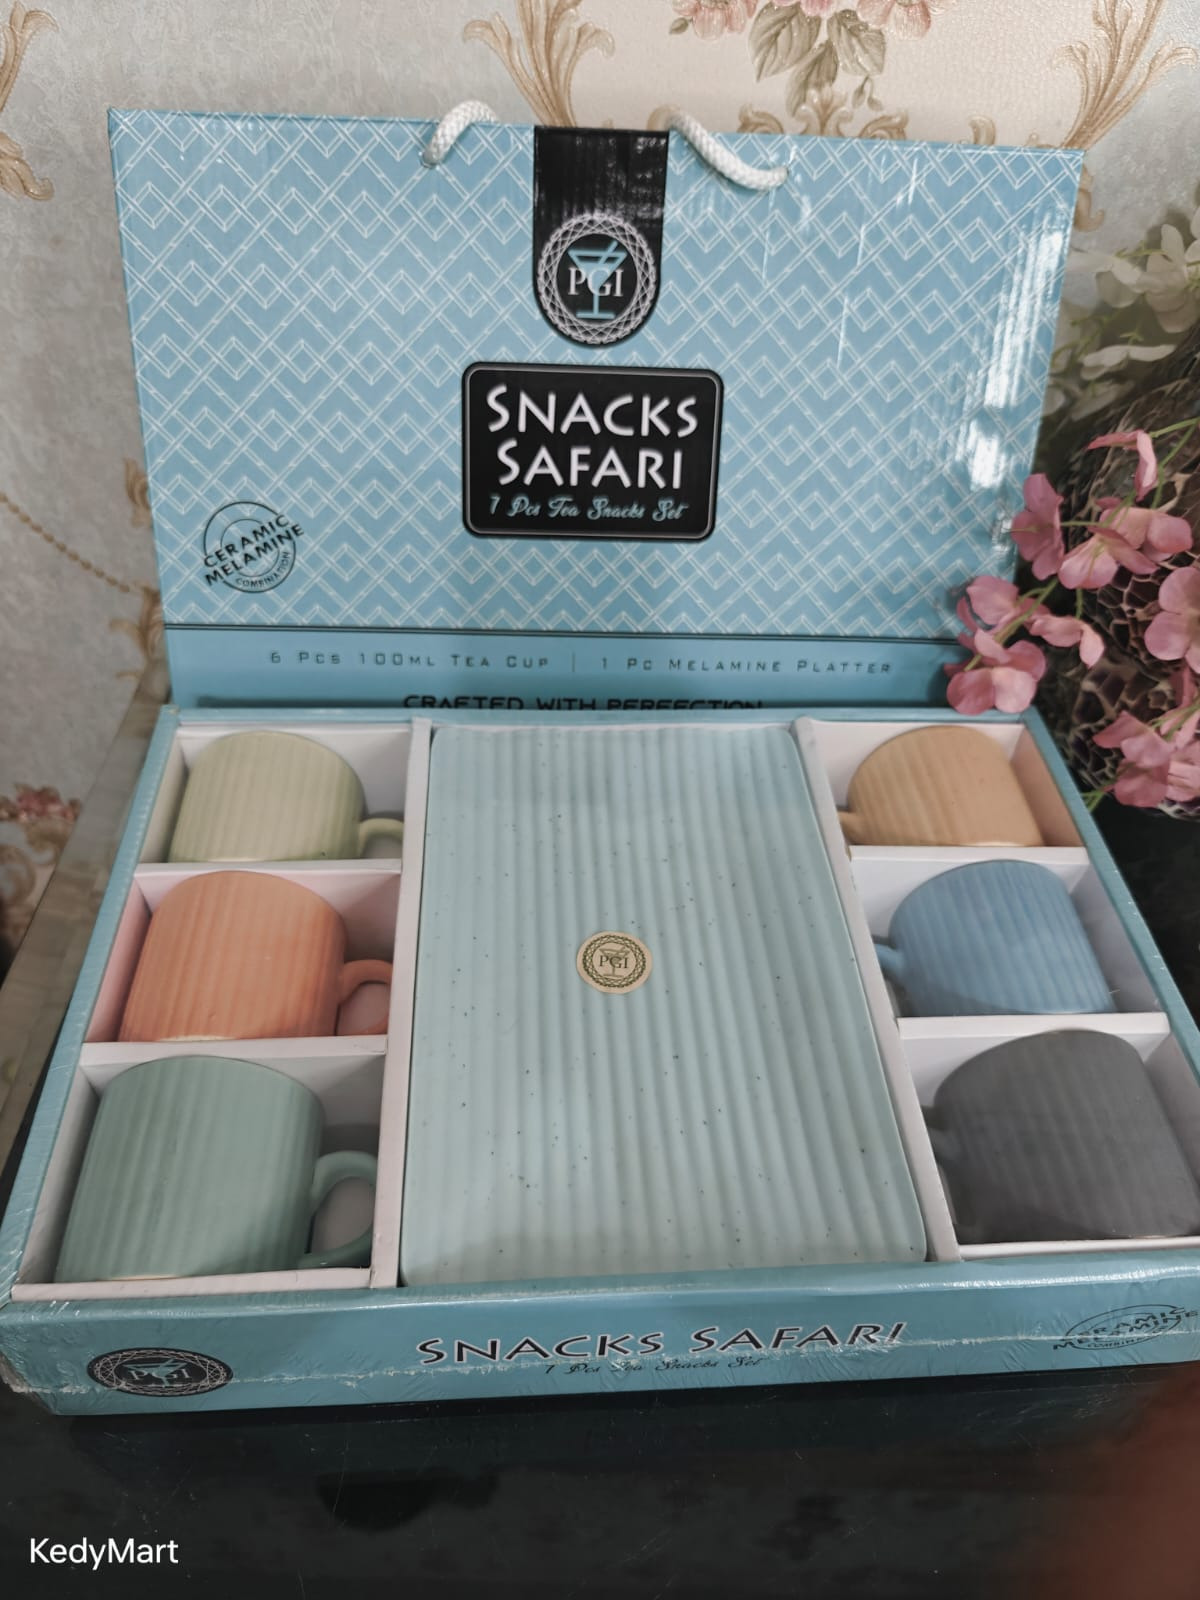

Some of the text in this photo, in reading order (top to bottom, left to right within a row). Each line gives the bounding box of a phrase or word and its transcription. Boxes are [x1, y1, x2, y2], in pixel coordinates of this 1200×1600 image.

[568, 267, 625, 298] PGI
[486, 384, 698, 438] SNACKS
[497, 438, 683, 489] SAFARI
[489, 495, 689, 523] 7 Pcs Tea Snacks Set
[203, 515, 290, 568] CERAMIC
[204, 523, 305, 587] MELAMINE
[271, 651, 281, 664] 6
[668, 658, 781, 673] MELAMINE
[796, 660, 891, 675] PLATTER
[600, 955, 628, 969] PGI
[416, 1321, 907, 1365] SNACKS SAFARI
